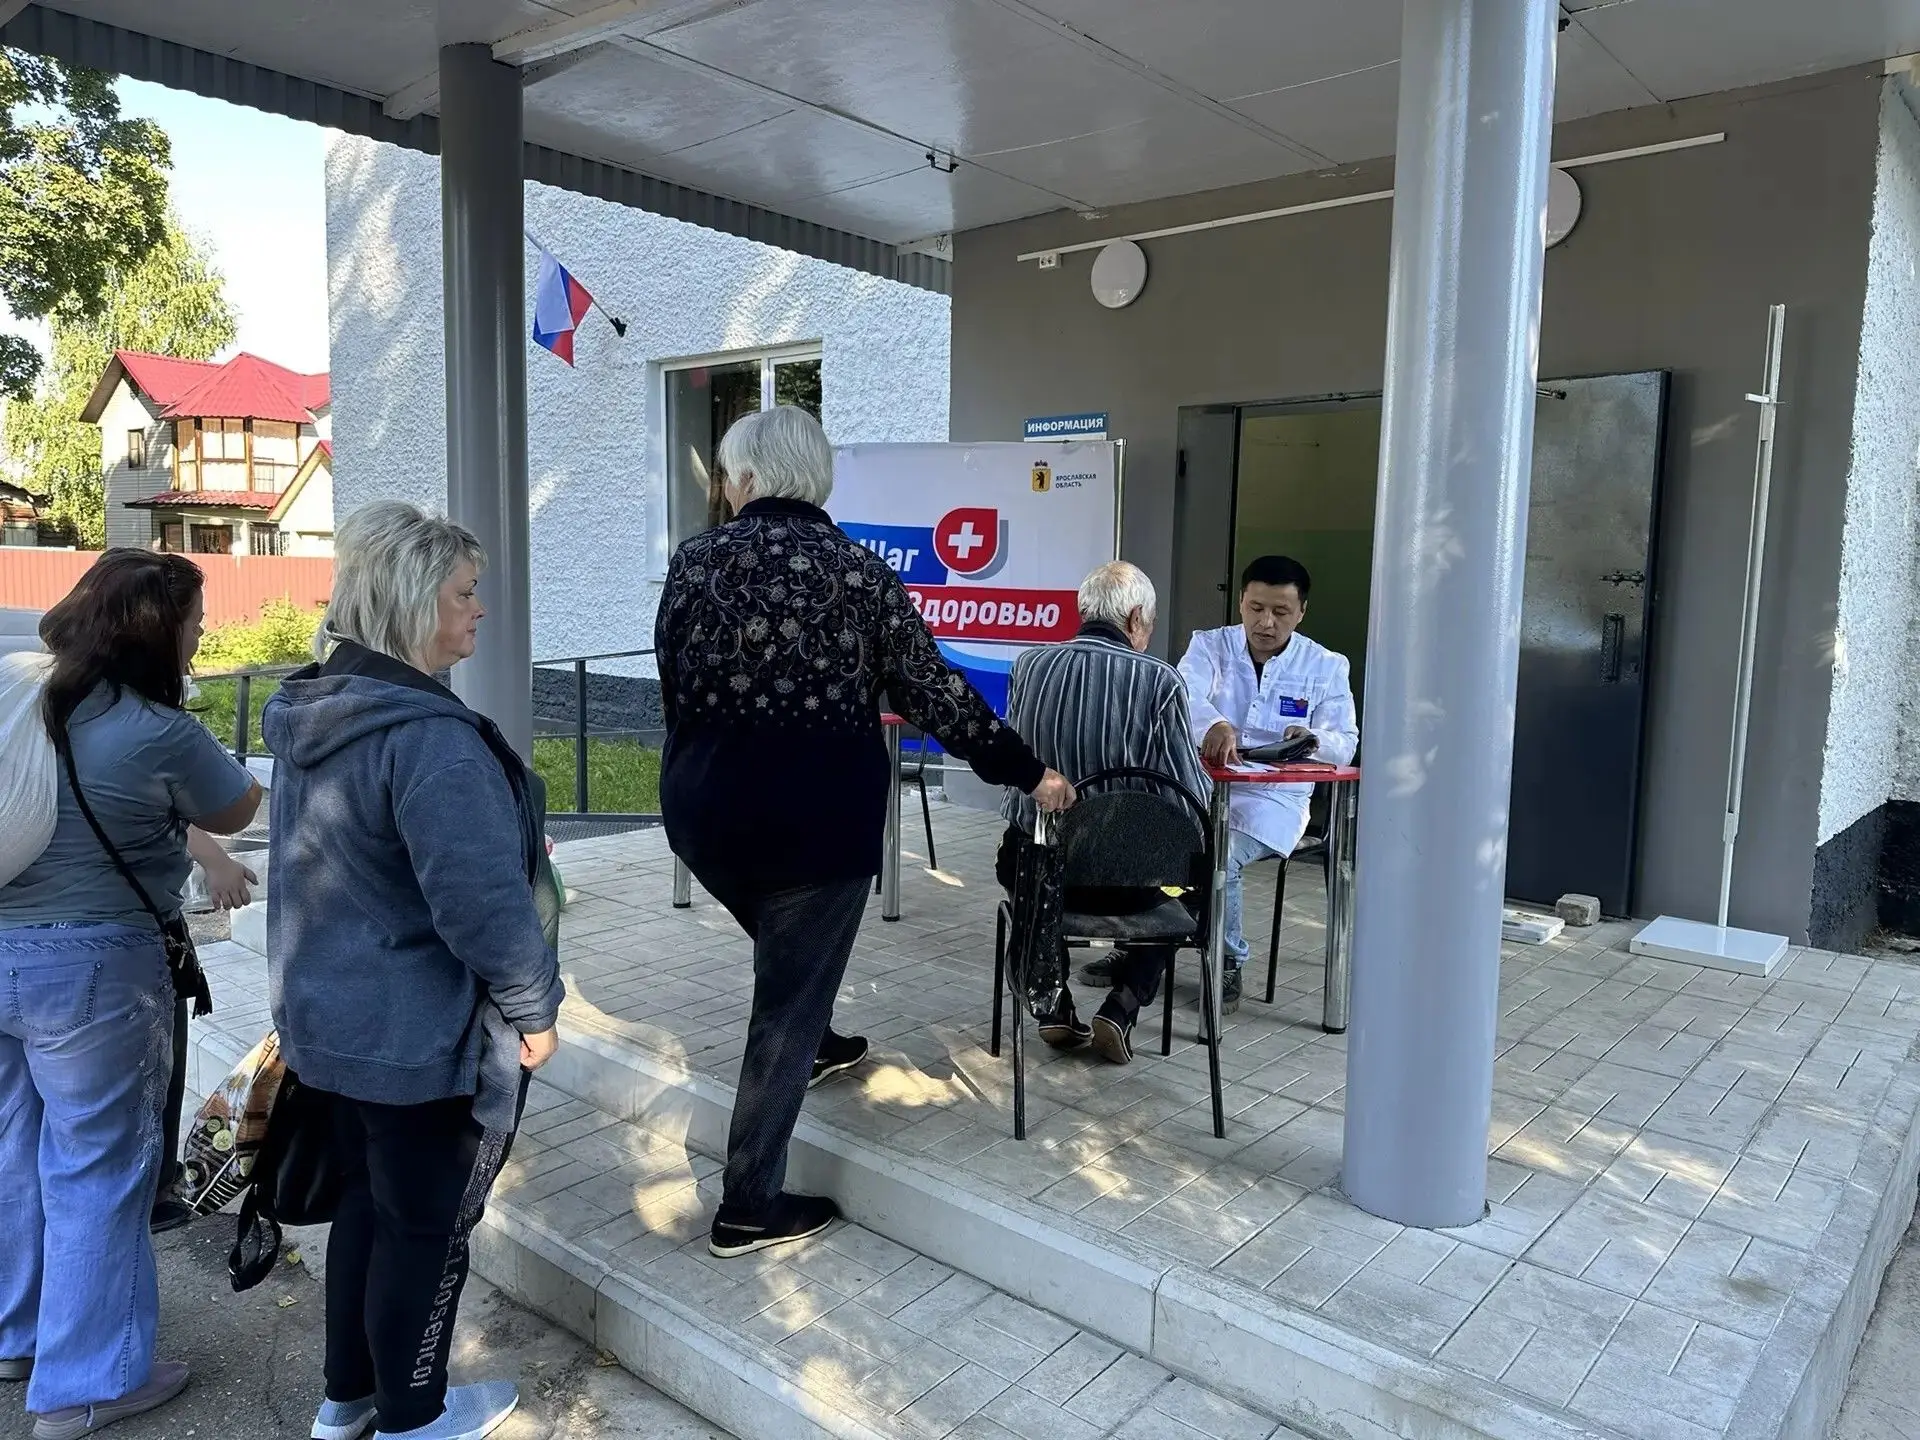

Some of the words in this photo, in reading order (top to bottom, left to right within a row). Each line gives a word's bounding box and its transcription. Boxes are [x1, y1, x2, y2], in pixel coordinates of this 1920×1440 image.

[1027, 418, 1104, 433] ИНФОРМАЦИЯ
[1055, 473, 1097, 481] ЯРОСЛАВСКАЯ
[1055, 481, 1082, 489] ОБЛАСТЬ
